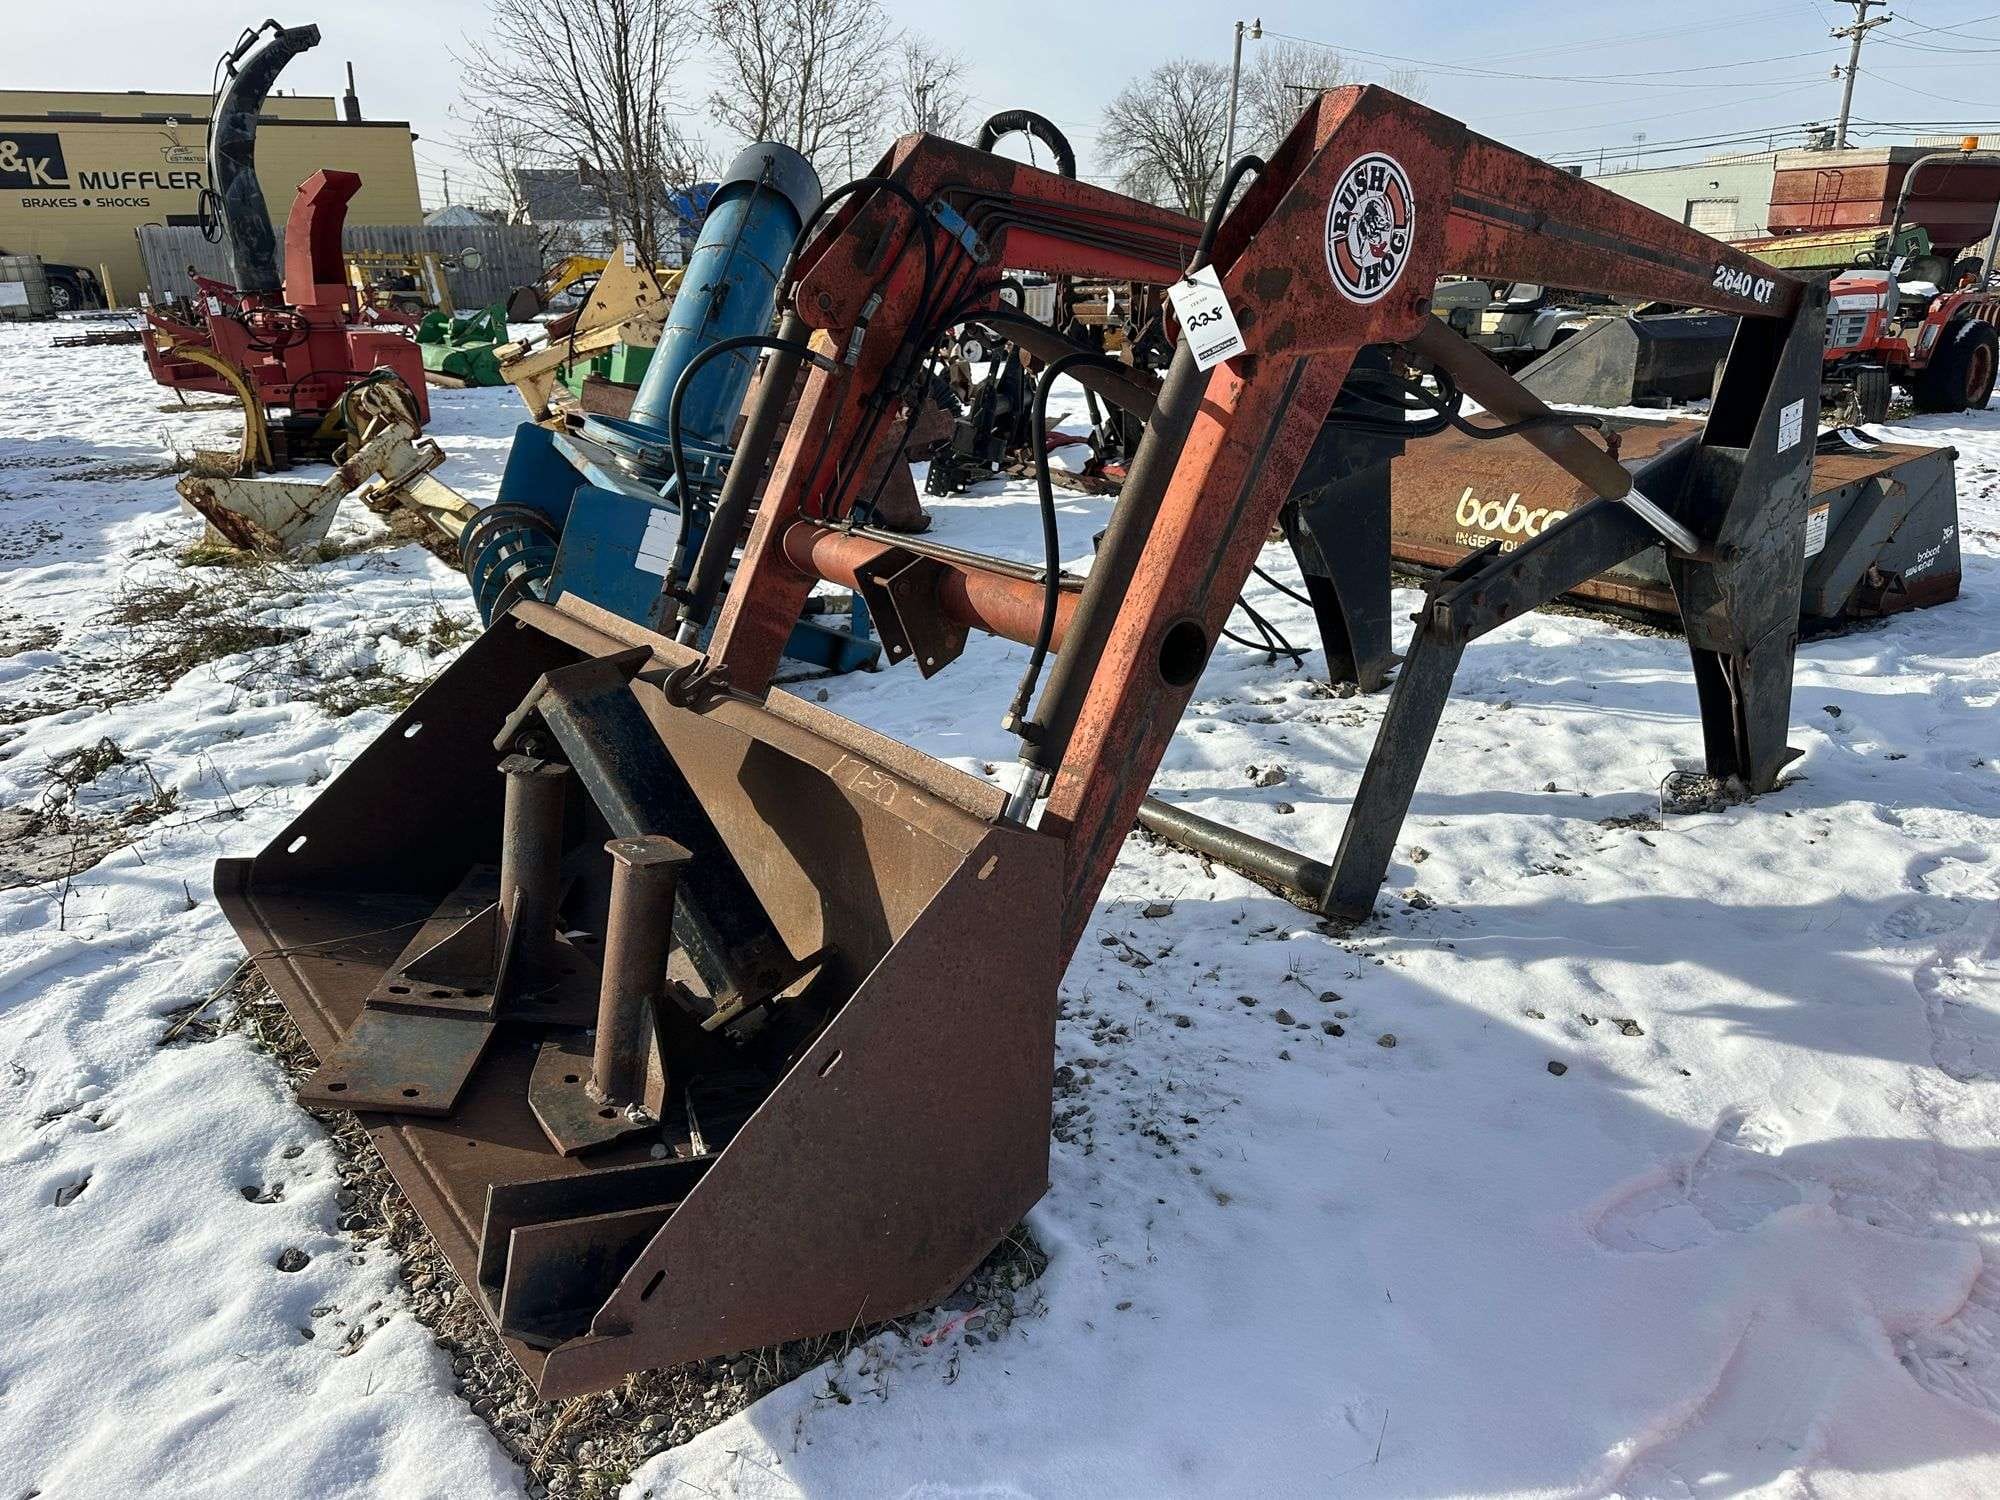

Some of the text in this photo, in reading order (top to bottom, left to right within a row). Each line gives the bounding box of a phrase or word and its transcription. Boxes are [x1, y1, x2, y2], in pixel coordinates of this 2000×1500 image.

[78, 171, 204, 190] MUFFLER
[22, 197, 150, 208] BRAKES SHOCKS
[1334, 165, 1406, 291] BUSH HOG
[1712, 265, 1775, 304] 2640 QT
[1187, 306, 1223, 332] 228
